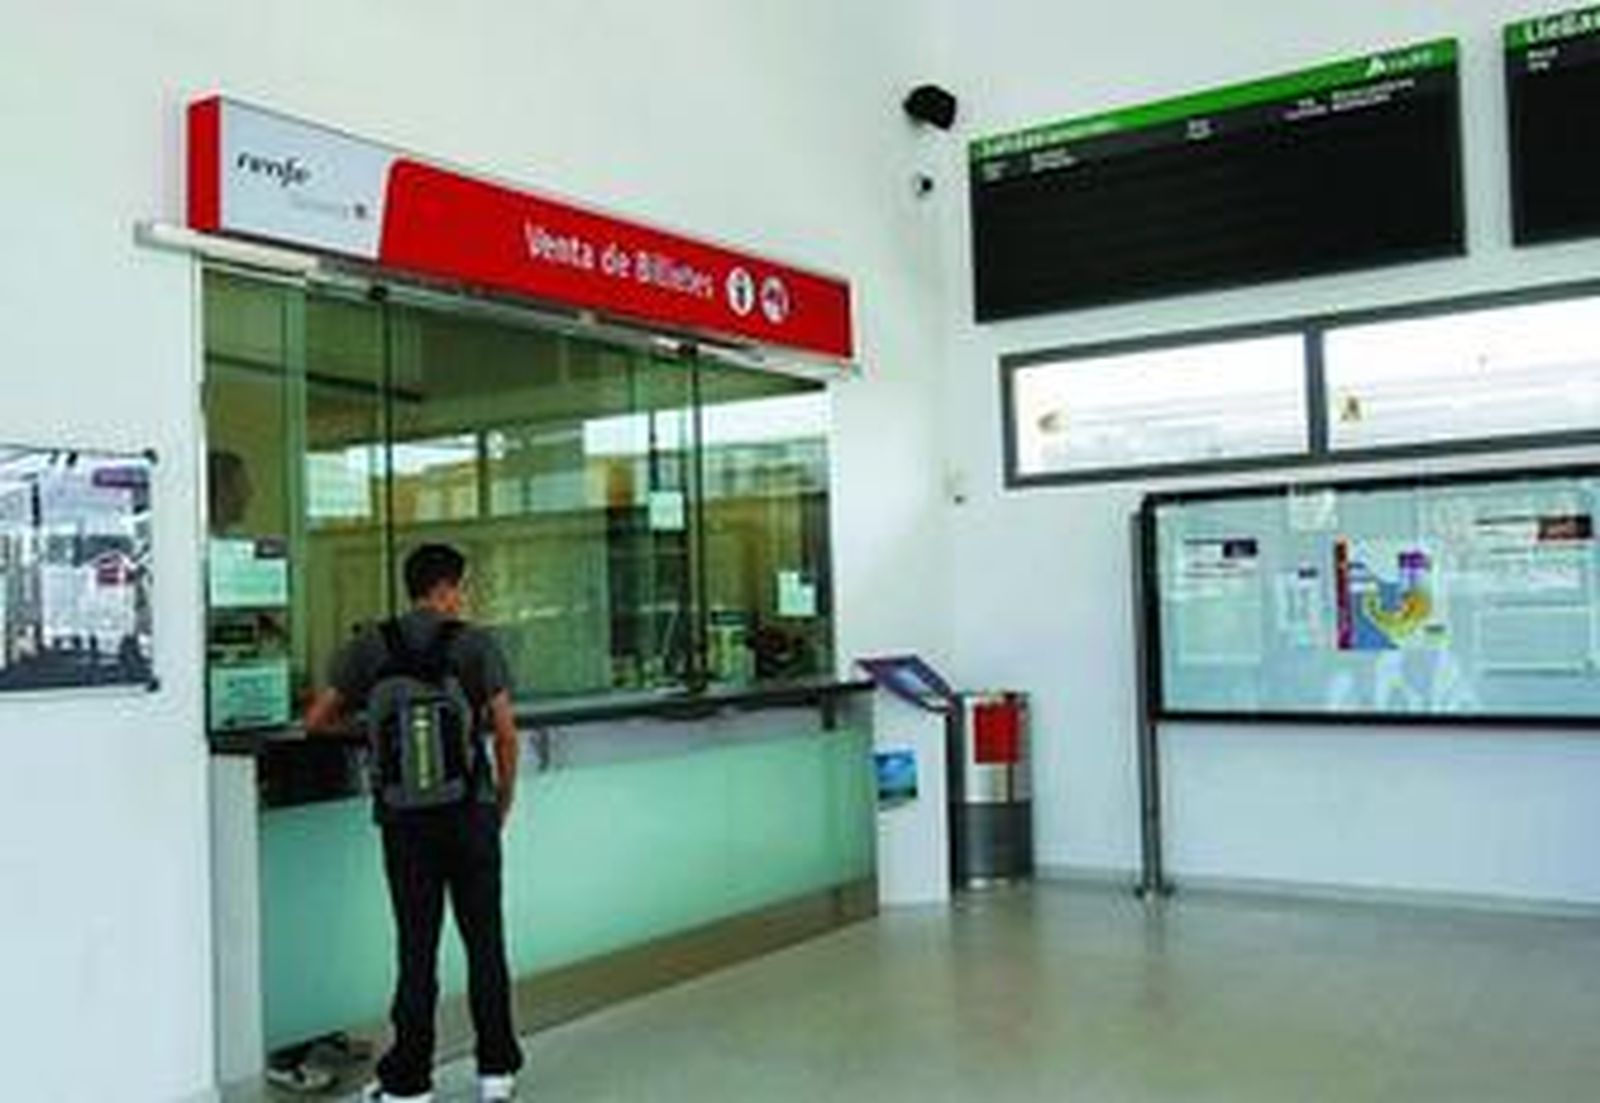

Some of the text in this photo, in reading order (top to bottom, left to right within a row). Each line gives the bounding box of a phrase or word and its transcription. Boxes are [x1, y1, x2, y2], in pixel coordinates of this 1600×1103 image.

[236, 151, 311, 188] renfe
[524, 219, 715, 299] Venta de Billetes
